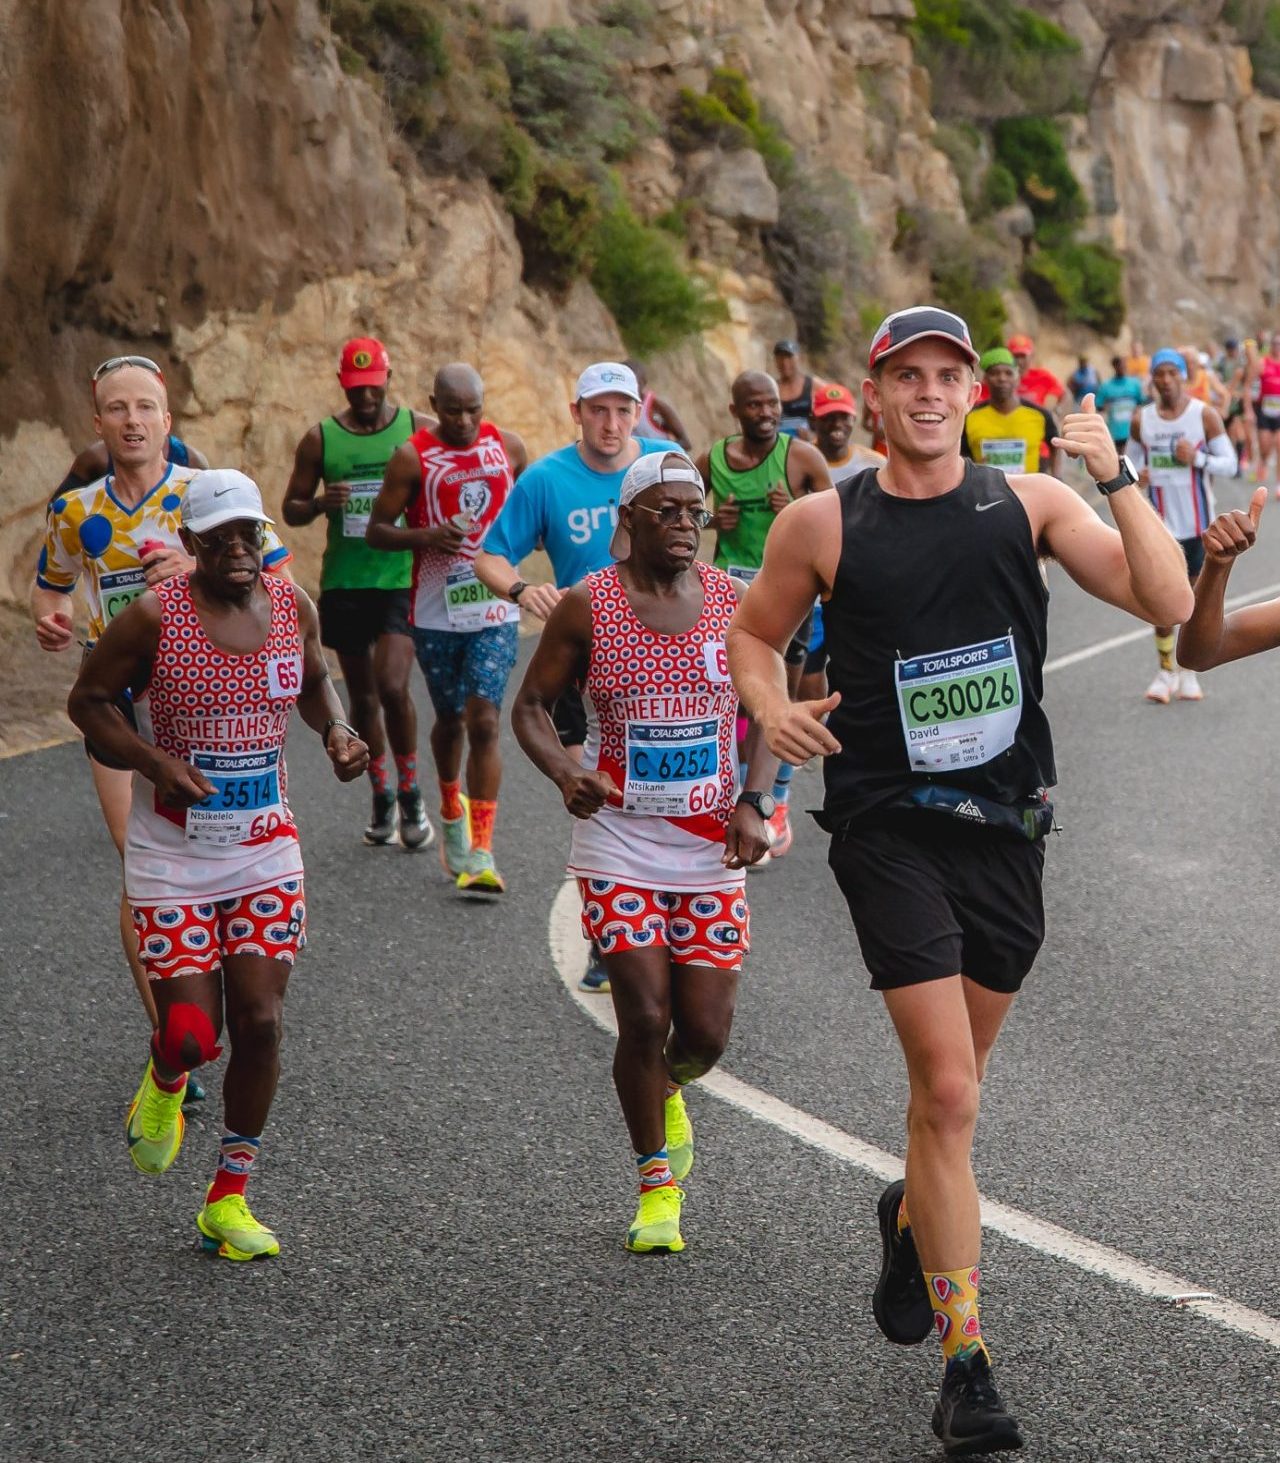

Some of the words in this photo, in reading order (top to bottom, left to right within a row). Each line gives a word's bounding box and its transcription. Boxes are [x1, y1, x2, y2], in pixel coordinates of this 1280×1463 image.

[484, 448, 505, 467] 40
[485, 605, 507, 622] 40
[922, 649, 989, 673] TOTALSPORTS
[277, 661, 299, 690] 65
[614, 696, 708, 720] CHEETAHS
[909, 672, 1014, 722] C30026
[176, 714, 270, 741] CHEETAHS
[271, 713, 288, 732] AC
[649, 725, 703, 738] TOTALSPORTS
[909, 726, 939, 741] David
[215, 756, 267, 768] TOTALSPORTS
[633, 751, 649, 778] C
[658, 747, 709, 779] 6252
[221, 776, 271, 808] 5514
[627, 781, 666, 792] Ntsikane
[688, 782, 717, 813] 60
[190, 811, 234, 821] Ntsikelelo
[250, 811, 281, 838] 60
